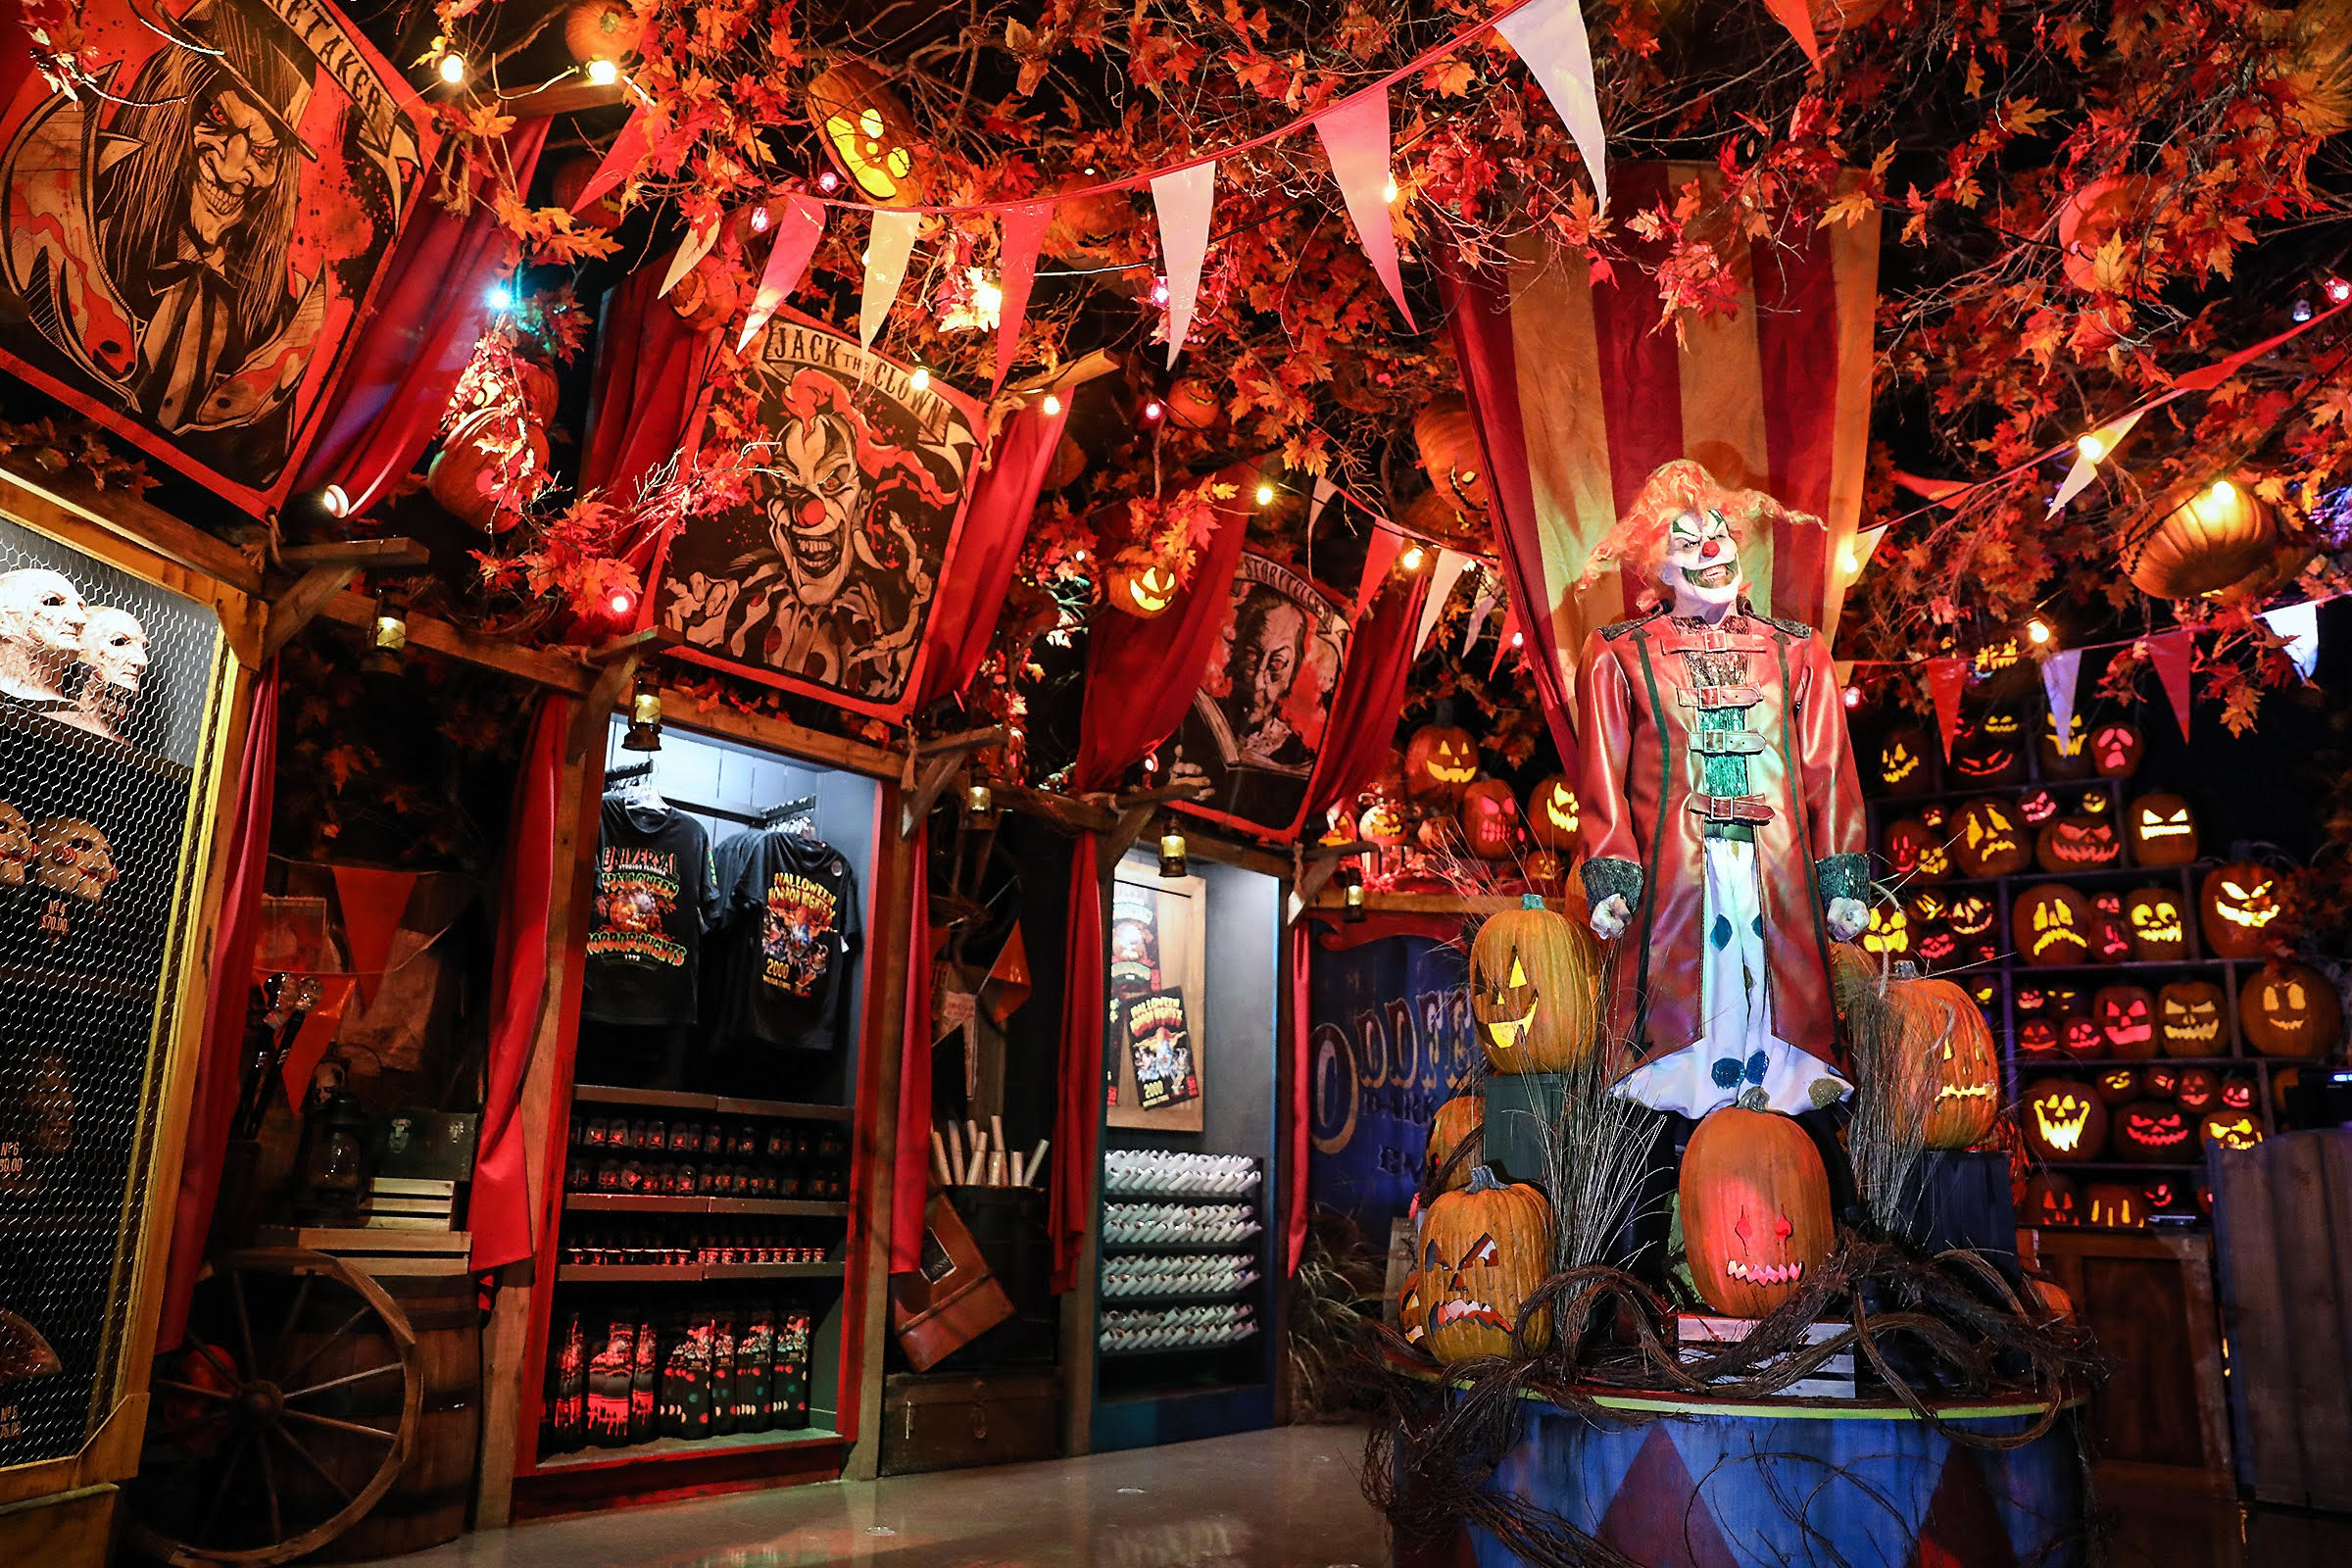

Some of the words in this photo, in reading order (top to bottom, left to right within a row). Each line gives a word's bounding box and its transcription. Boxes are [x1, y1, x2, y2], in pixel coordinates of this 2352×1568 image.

[774, 326, 841, 368] JACK
[874, 362, 944, 428] CLOWN
[1245, 556, 1332, 617] STORYTELLER
[602, 872, 679, 899] HALLOWEEN
[774, 872, 837, 906] HALLOWEEN
[766, 957, 790, 979] 2000
